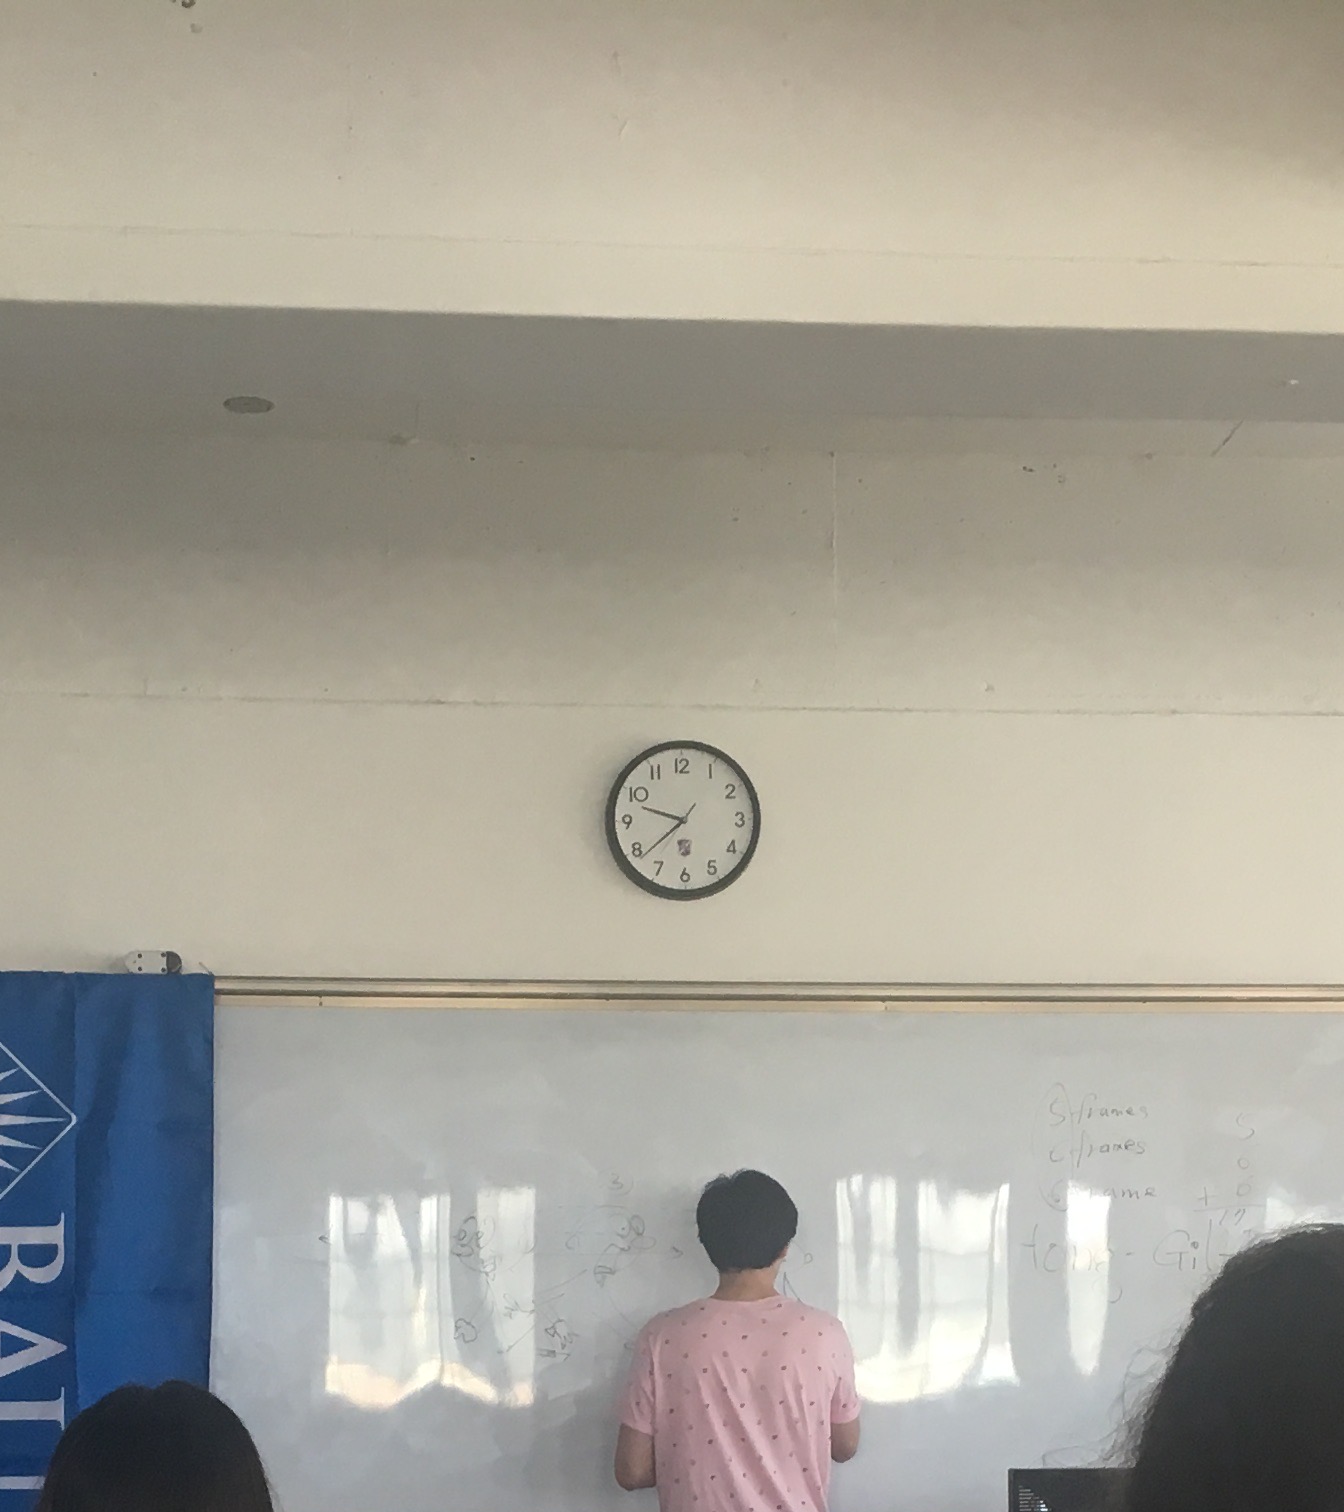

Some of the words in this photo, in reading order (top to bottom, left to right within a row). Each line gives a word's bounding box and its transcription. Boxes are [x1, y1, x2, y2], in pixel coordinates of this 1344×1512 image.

[650, 763, 661, 780] 11
[674, 757, 690, 774] 12
[708, 763, 713, 779] 1
[629, 786, 649, 802] 10
[724, 784, 736, 799] 2
[621, 814, 633, 830] 9
[734, 812, 745, 828] 3
[631, 842, 643, 858] 8
[726, 839, 737, 854] 4
[653, 861, 664, 876] 7
[679, 867, 691, 883] 6
[707, 860, 717, 875] 5
